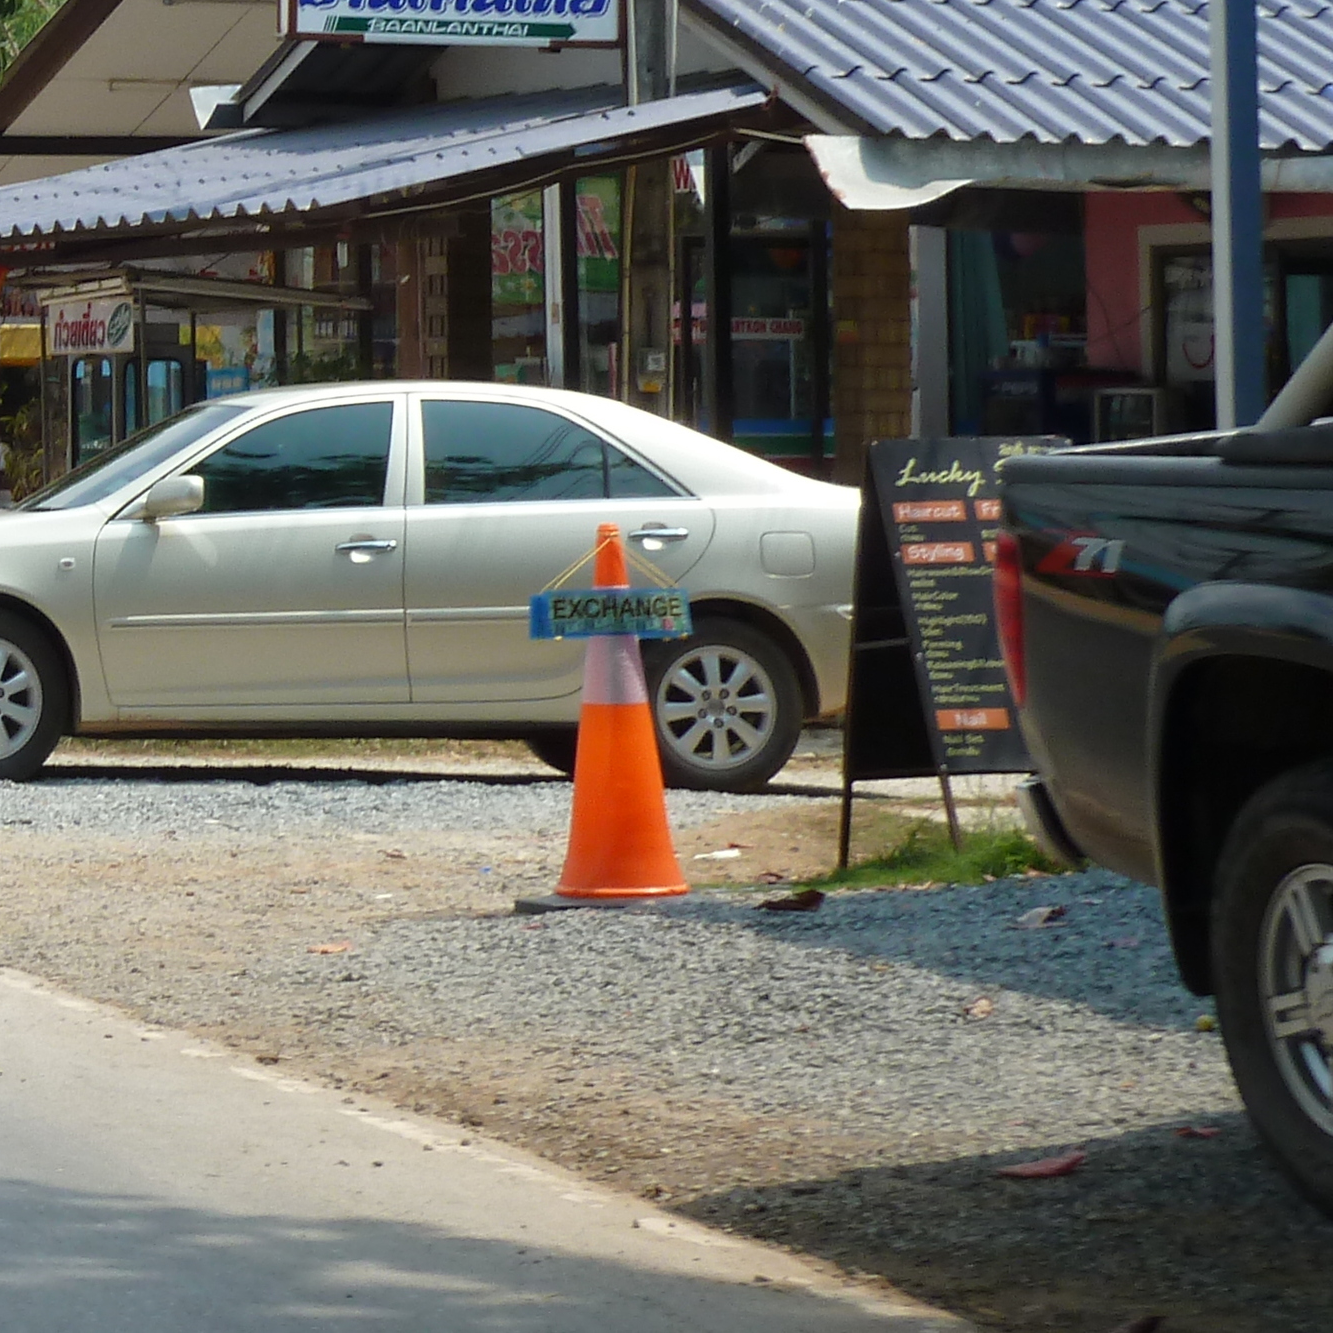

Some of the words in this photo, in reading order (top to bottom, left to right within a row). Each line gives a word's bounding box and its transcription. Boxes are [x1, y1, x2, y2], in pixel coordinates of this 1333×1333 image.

[368, 18, 528, 37] BAANLANTHAI
[895, 458, 986, 497] Lucky
[907, 544, 965, 562] Styling
[552, 596, 683, 620] EXCHANGE
[953, 712, 988, 726] Nail
